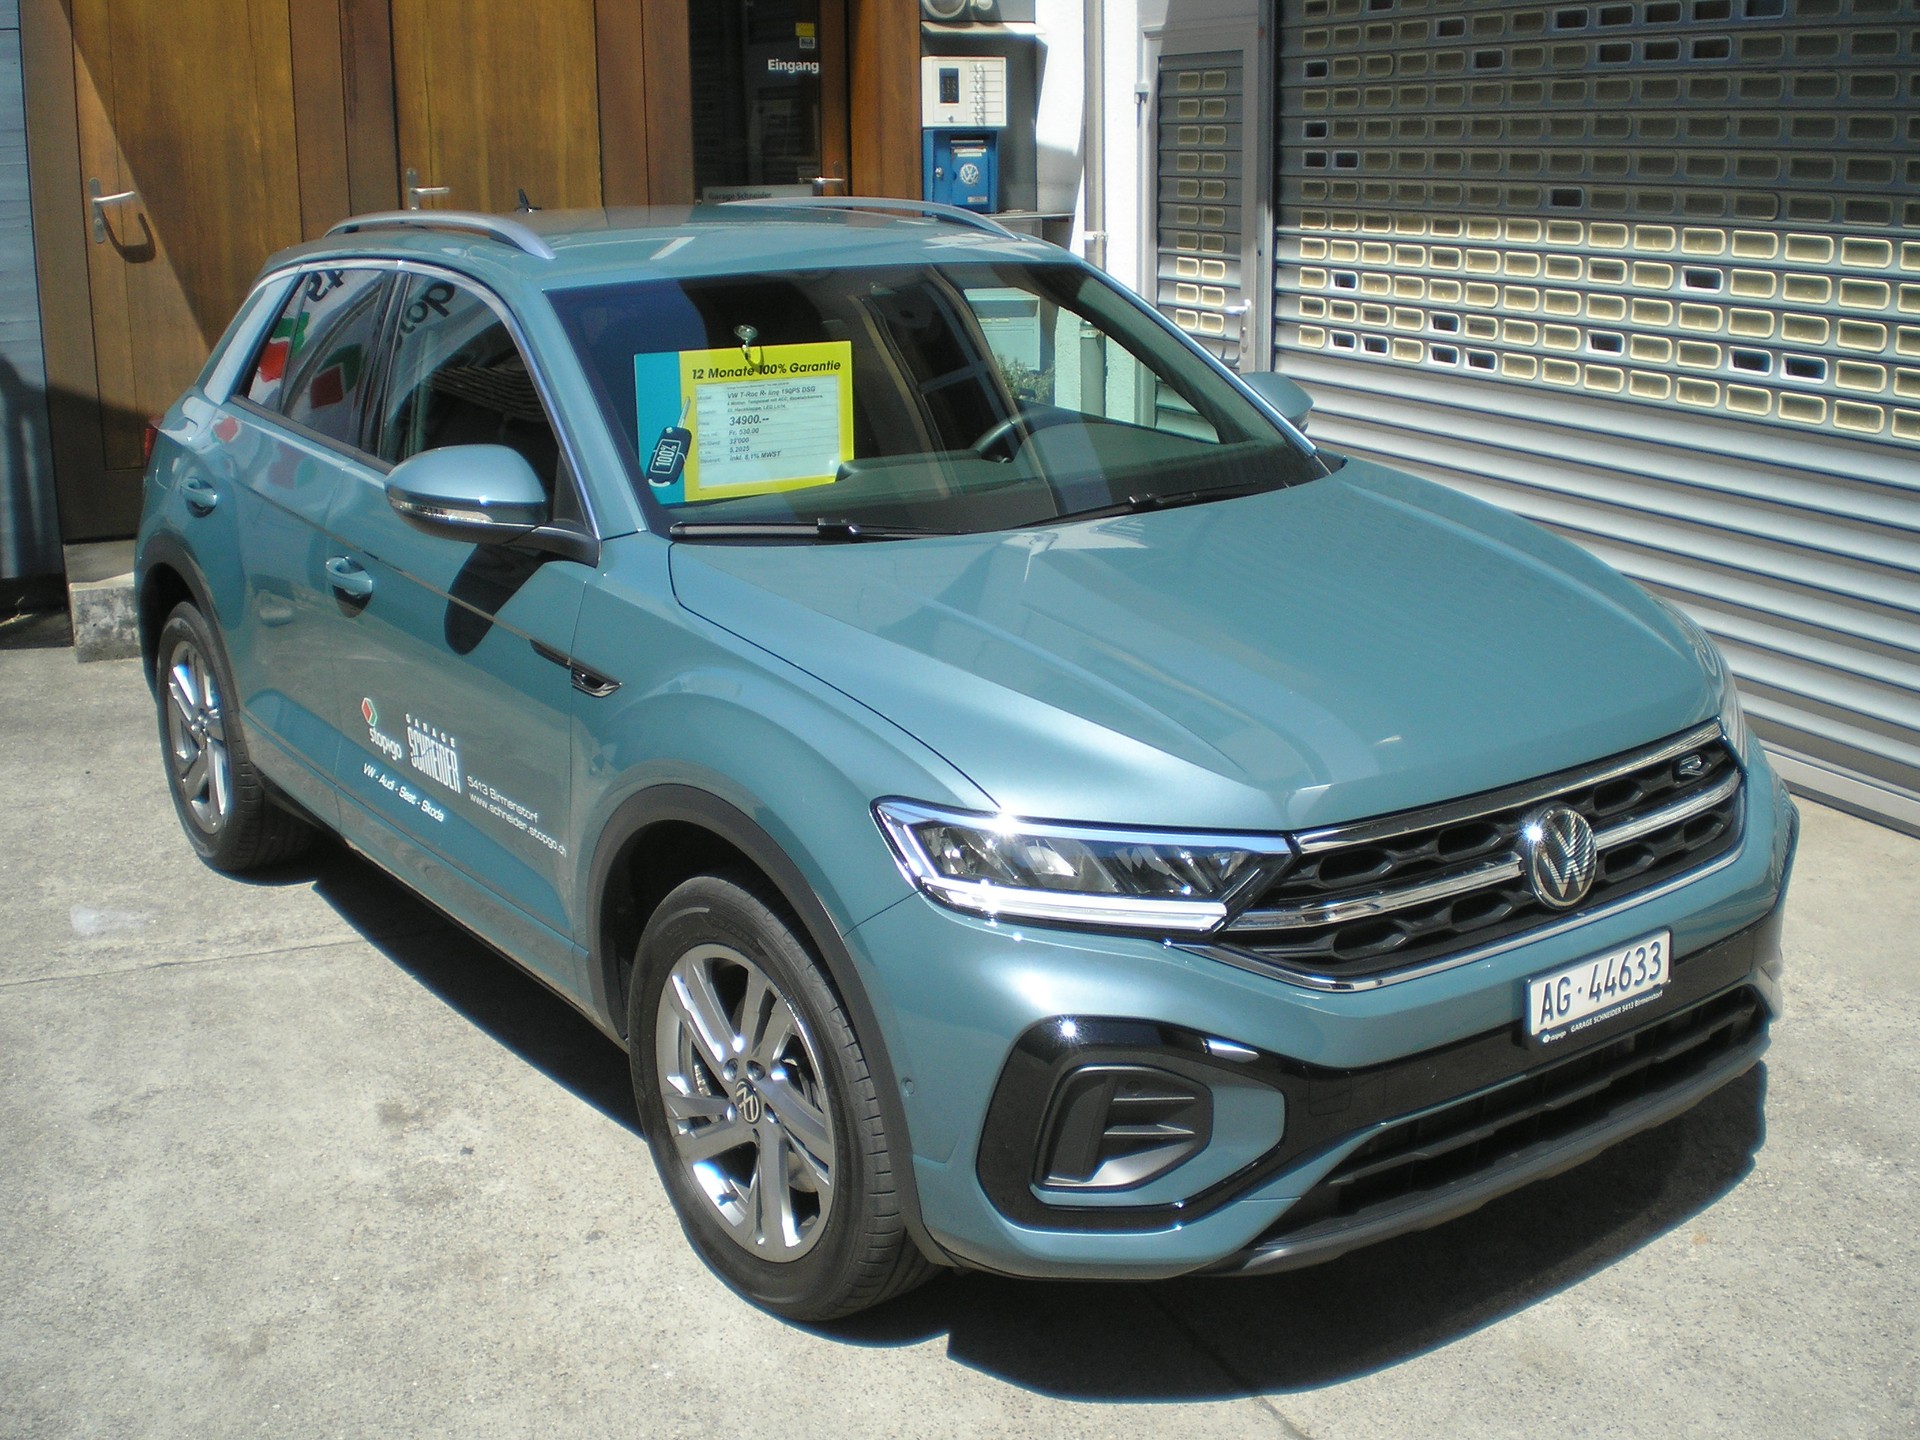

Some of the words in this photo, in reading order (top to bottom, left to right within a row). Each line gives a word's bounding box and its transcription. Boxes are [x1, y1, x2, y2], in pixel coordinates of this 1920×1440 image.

[767, 59, 820, 73] Eingang
[691, 369, 704, 379] 12
[708, 365, 755, 379] Monate
[758, 363, 787, 376] 100%
[789, 360, 841, 374] Garantie
[655, 444, 677, 466] 100%
[761, 450, 781, 458] MWST
[405, 712, 455, 748] GARAGE
[407, 726, 461, 793] SCHNEIDER
[363, 763, 376, 778] VW
[379, 774, 396, 790] Audi
[399, 786, 416, 805] Seat
[421, 800, 444, 822] Skoda
[467, 775, 488, 796] 5413
[489, 787, 538, 824] Birmenstorf
[1540, 976, 1571, 1025] AG
[1588, 941, 1661, 1003] 44633
[1571, 1018, 1593, 1033] GARAGE
[1593, 1006, 1621, 1024] SCHNEIDER
[1634, 989, 1663, 1008] Birmenstorf
